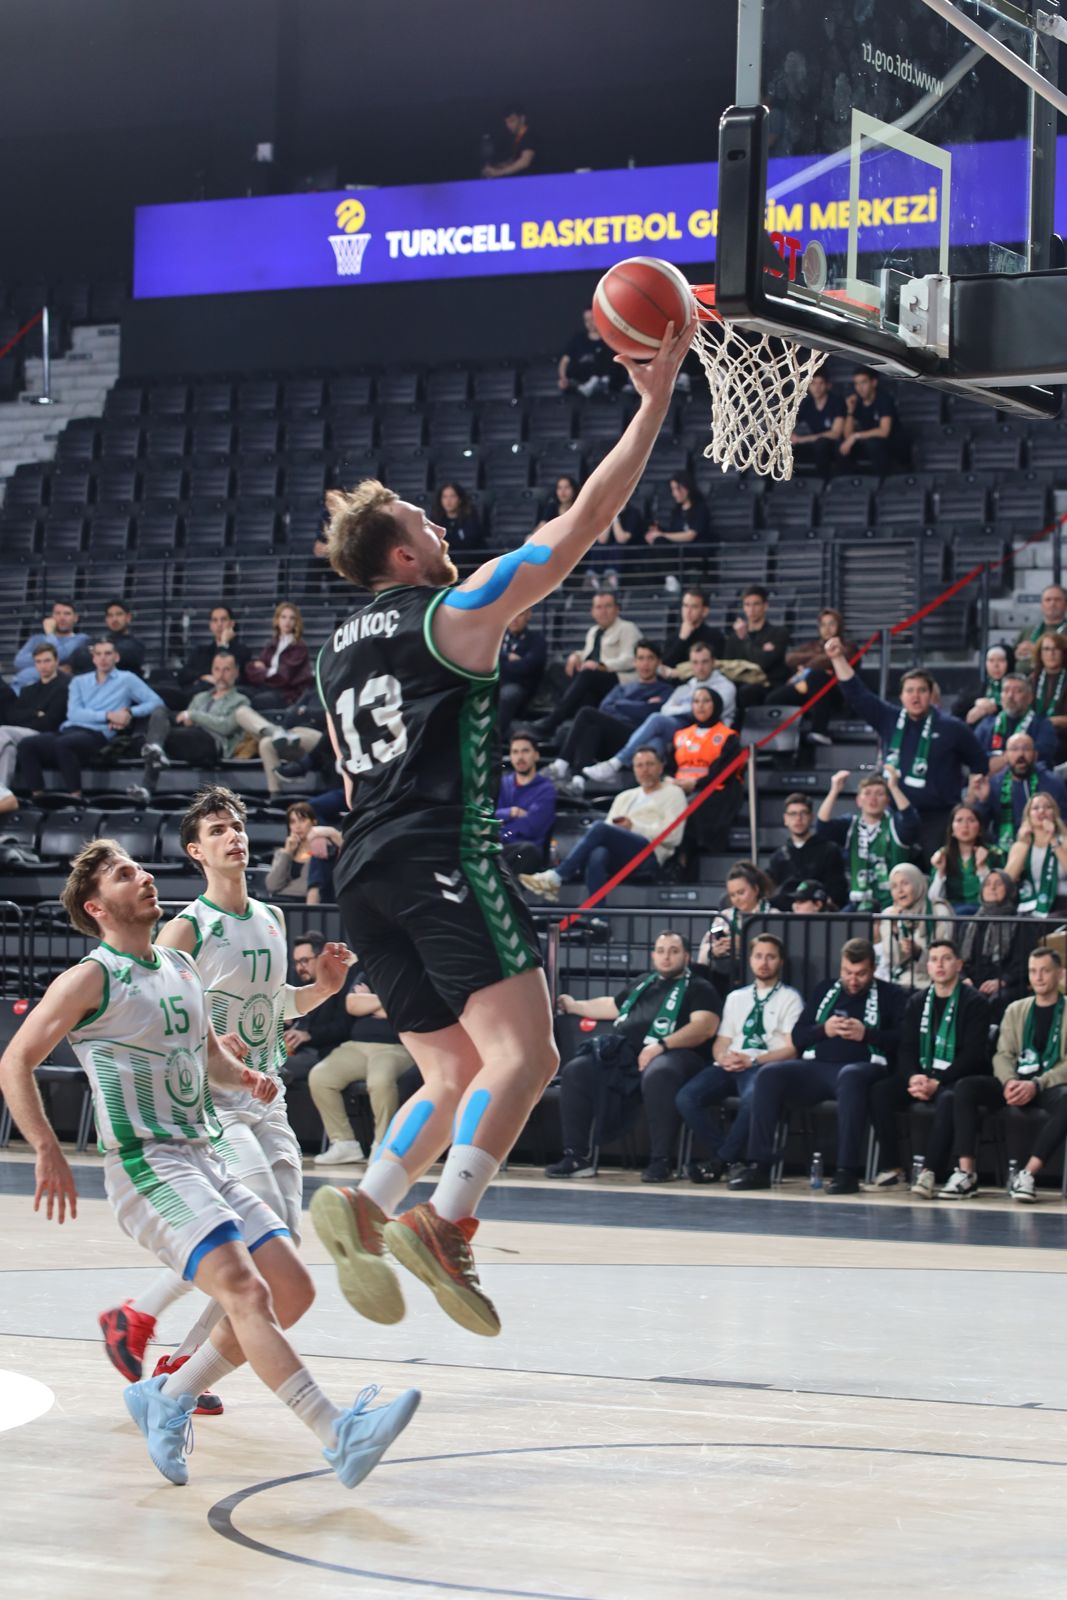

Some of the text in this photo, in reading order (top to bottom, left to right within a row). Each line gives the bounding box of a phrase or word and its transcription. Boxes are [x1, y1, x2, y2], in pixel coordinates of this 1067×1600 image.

[385, 223, 516, 258] TURKCELL
[521, 212, 682, 249] BASKETBOL
[810, 187, 938, 230] MERKEZİ
[333, 610, 400, 653] CAN KOÇ
[336, 674, 408, 774] 13
[242, 949, 272, 983] 77
[160, 996, 190, 1036] 15
